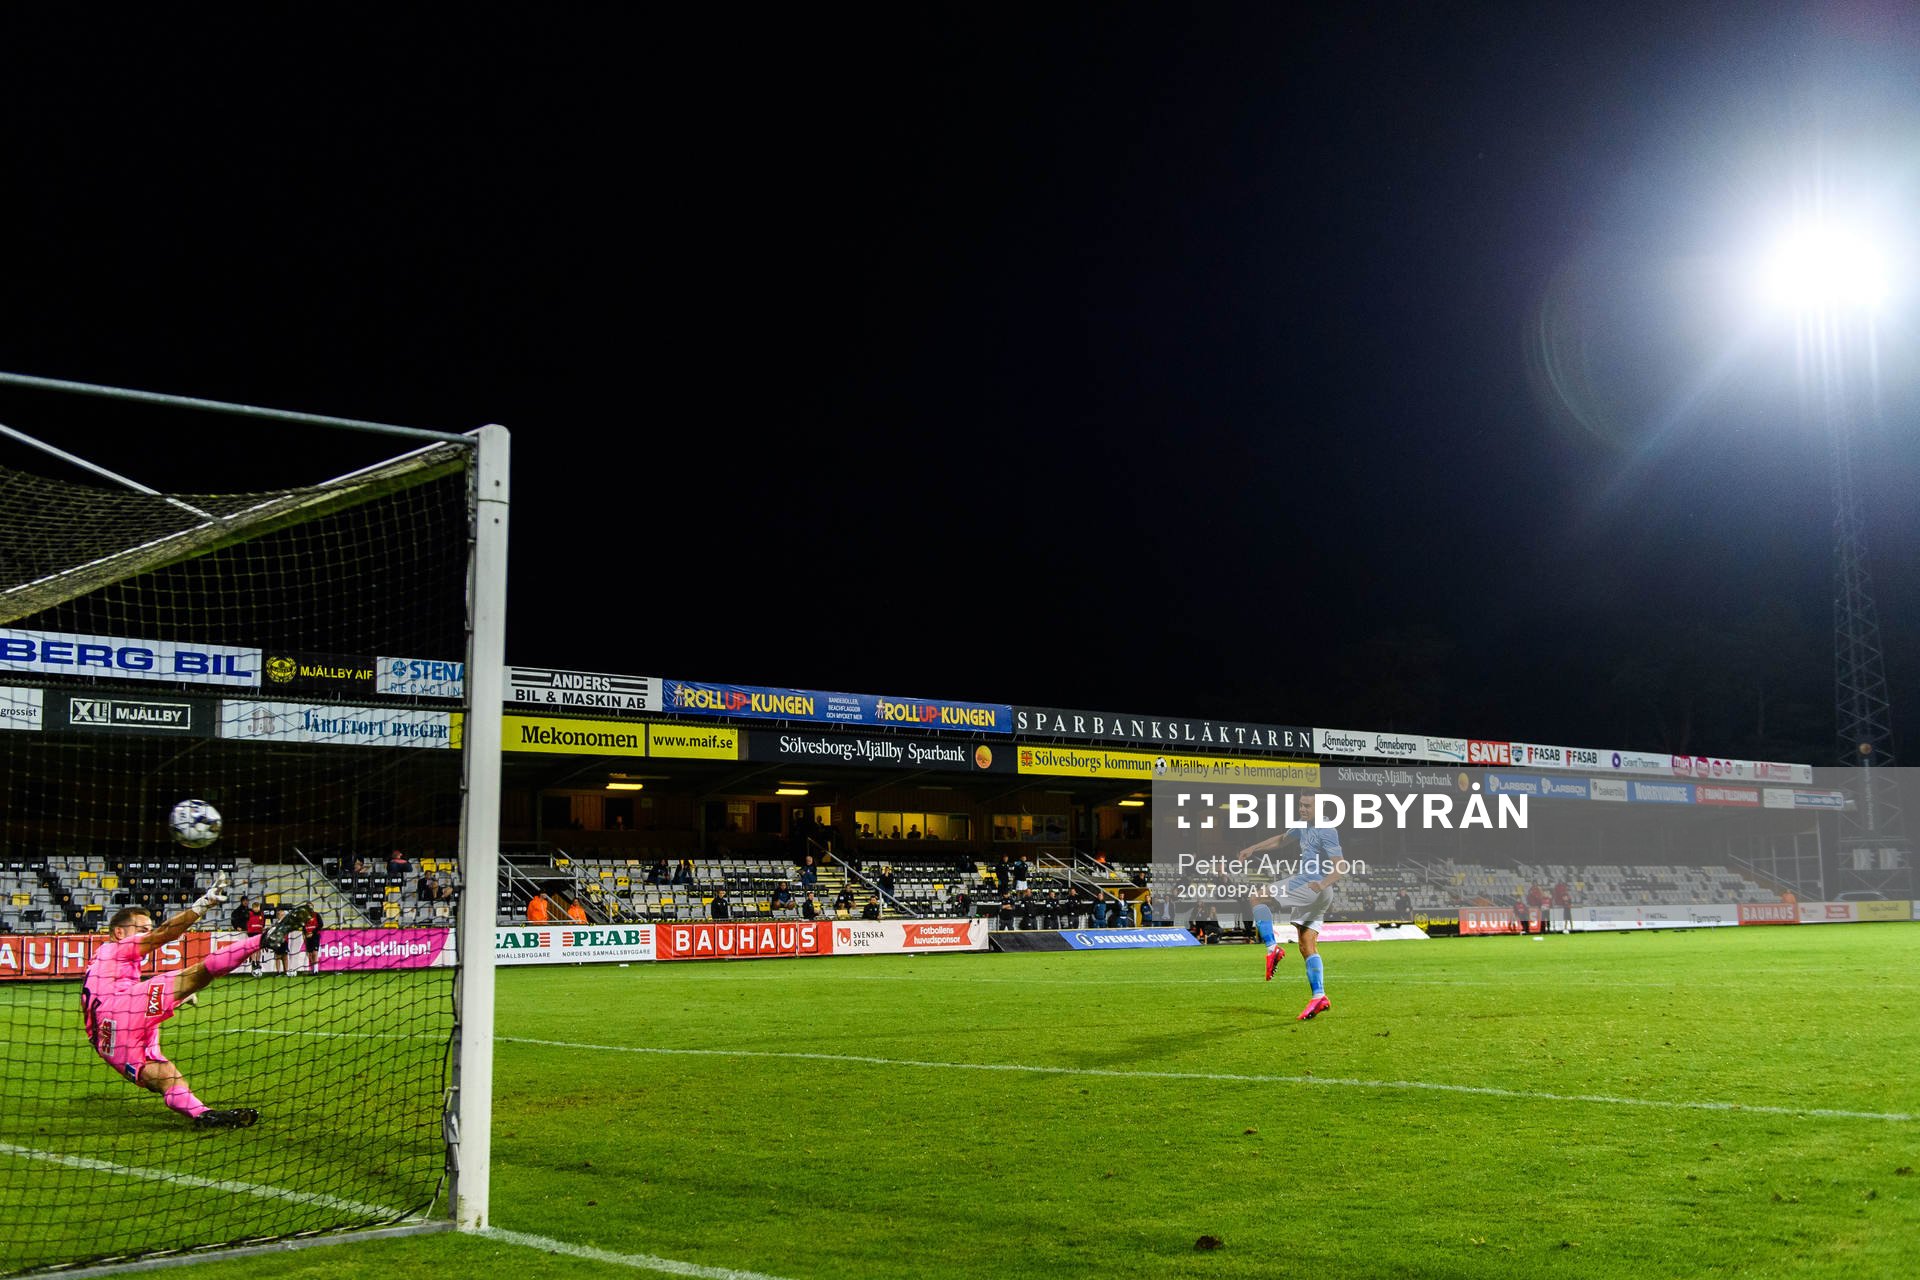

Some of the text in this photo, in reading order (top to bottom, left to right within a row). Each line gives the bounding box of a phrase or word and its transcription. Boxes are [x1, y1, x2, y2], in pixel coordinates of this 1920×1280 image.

[0, 638, 252, 678] BERG BIL
[300, 664, 352, 679] MJÄLLBY
[355, 669, 374, 680] AIF
[390, 683, 464, 697] RECYCLIN
[552, 674, 611, 691] ANDERS
[516, 689, 646, 709] BIL & MASKIN AB
[0, 707, 37, 718] grossist
[116, 707, 182, 722] MJÄLLBY
[392, 722, 447, 738] BYGGER
[521, 725, 638, 748] Mekonomen
[1017, 711, 1311, 749] SPARBANKSLÄKTAREN
[653, 733, 733, 749] www.maif.se
[780, 736, 966, 763] Sölvesborg-Mjällby Sparbank
[1322, 731, 1366, 751] Lönneberga
[1375, 735, 1416, 753] Lönneberga
[1035, 750, 1151, 772] Sölvesborgs kommun
[1470, 743, 1508, 763] SAVE
[1534, 747, 1560, 761] FASAB
[1572, 750, 1597, 764] FASAB
[1170, 759, 1209, 778] Mjällby
[1244, 765, 1304, 782] hemmaplan
[1416, 771, 1452, 788] Sparbank
[1500, 781, 1536, 792] LARSSON
[1550, 783, 1586, 794] LARSSON
[1469, 911, 1538, 929] BAUHAS
[1743, 905, 1794, 920] BAUHAUS
[573, 930, 640, 947] PEAB
[675, 926, 815, 951] BAUHAUS
[853, 931, 884, 939] SVENSKA
[920, 926, 954, 935] Fotbollens
[1094, 933, 1186, 944] SVENSKA CUPEN
[496, 932, 540, 949] AB
[854, 939, 870, 947] SPEL
[914, 935, 960, 946] huvudsponsor
[318, 940, 431, 960] Heja backlinjen!
